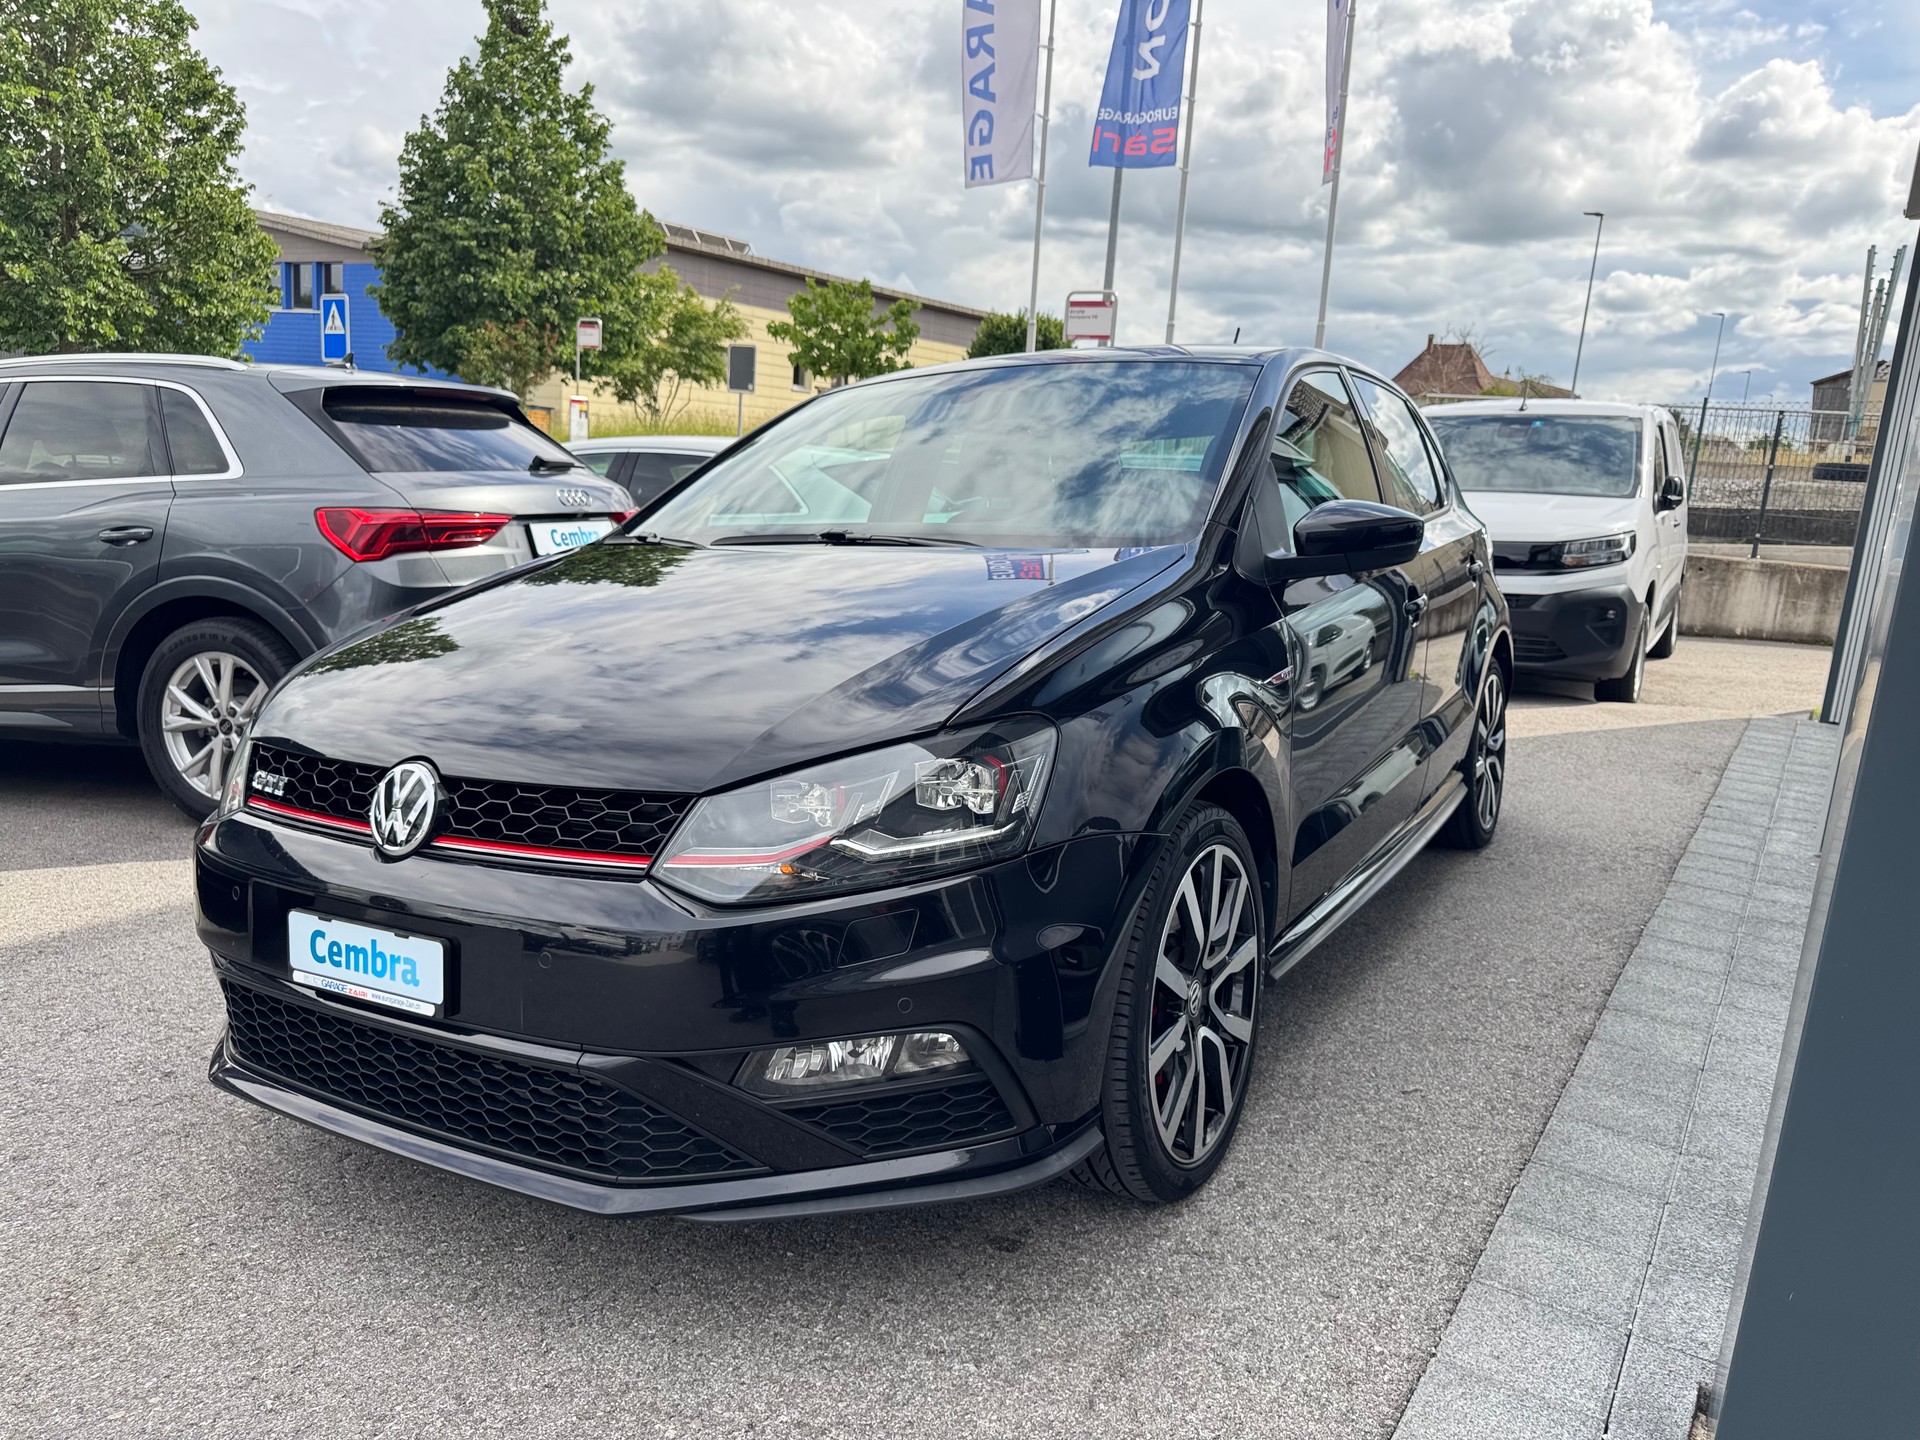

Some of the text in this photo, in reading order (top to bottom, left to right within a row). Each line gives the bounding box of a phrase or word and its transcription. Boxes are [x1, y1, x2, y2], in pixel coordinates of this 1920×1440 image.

[551, 527, 600, 547] Cembra
[252, 770, 289, 797] GTI
[310, 929, 420, 988] Cembra
